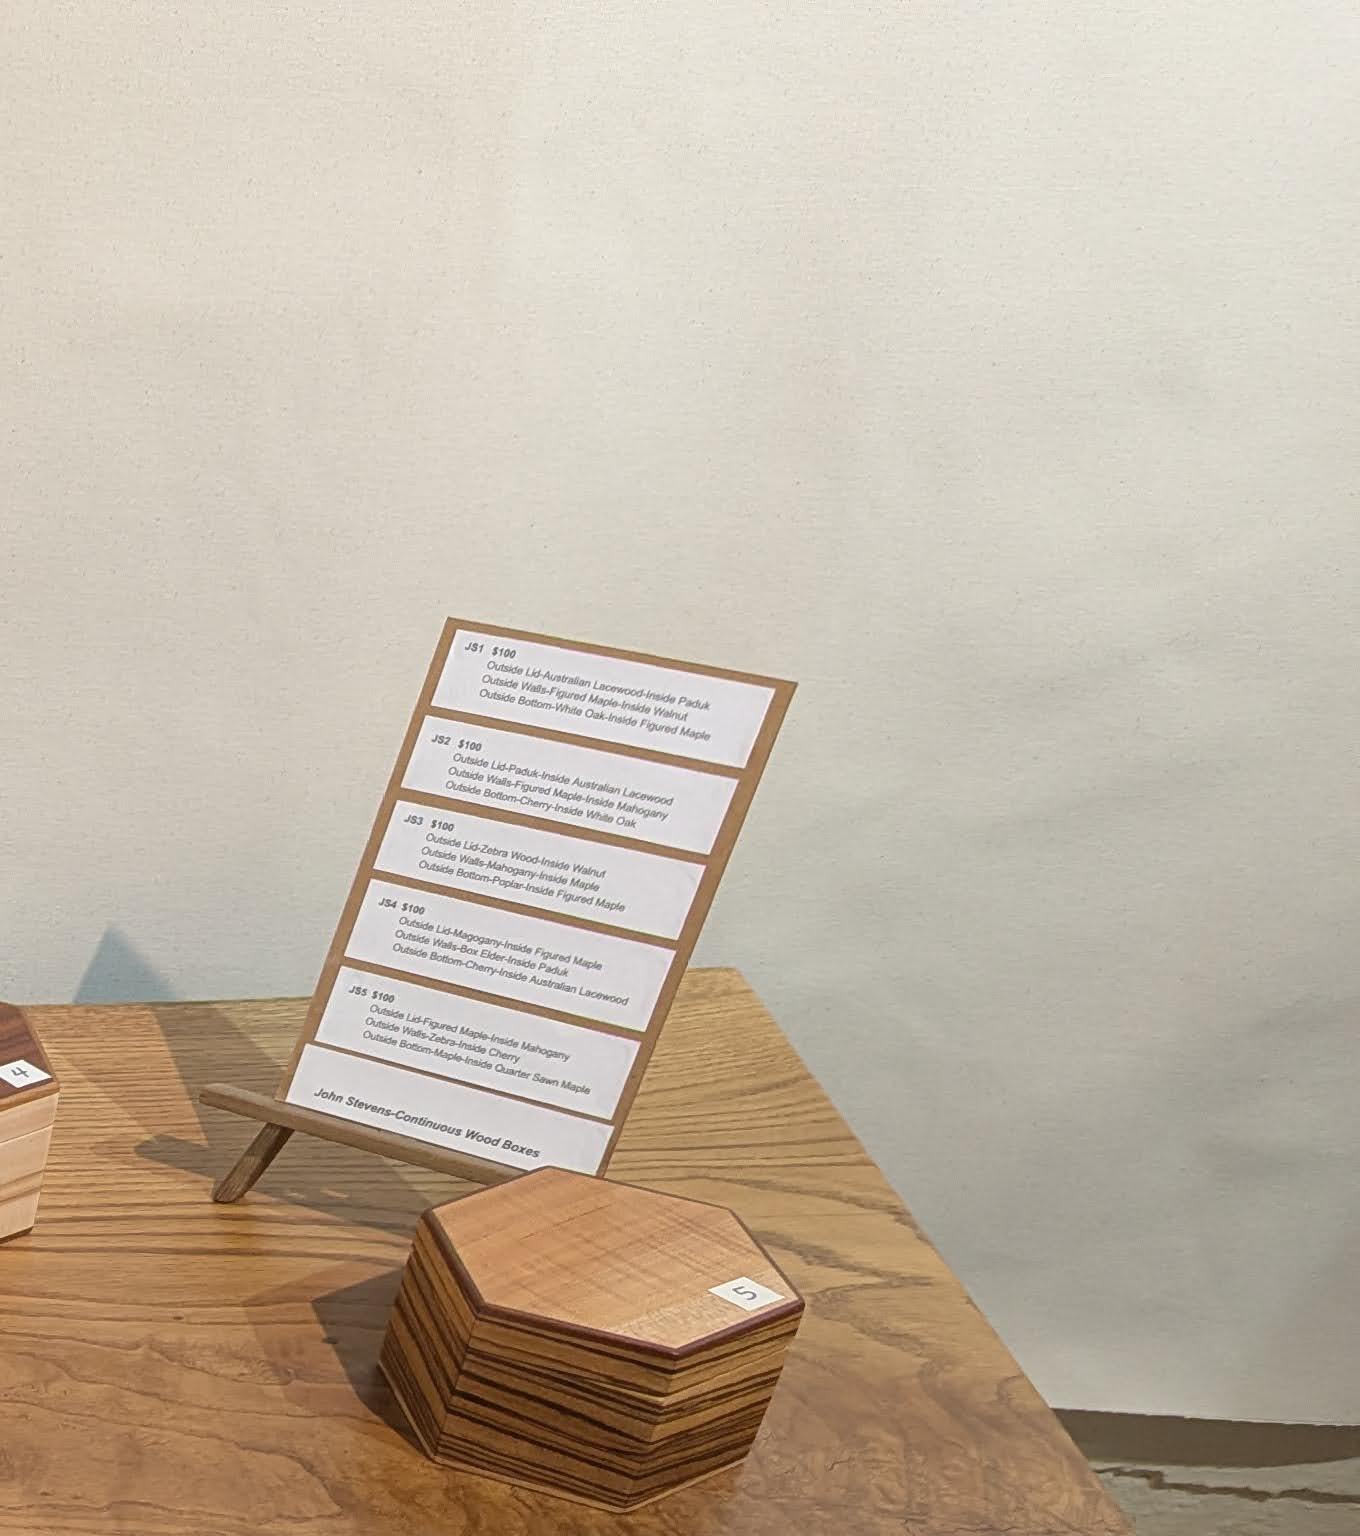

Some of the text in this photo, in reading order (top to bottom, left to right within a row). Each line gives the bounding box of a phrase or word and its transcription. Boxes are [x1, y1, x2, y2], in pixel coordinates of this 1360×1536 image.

[464, 641, 517, 660] JS1 $100
[481, 673, 520, 690] Outside
[653, 705, 689, 722] Walnut
[486, 660, 524, 676] Outside
[677, 696, 711, 711] Paduk
[479, 688, 517, 704] Outside
[639, 718, 680, 735] Figured
[678, 725, 712, 742] Maple
[431, 734, 483, 752] JS2 $100
[445, 779, 482, 796] Outside
[615, 815, 637, 829] Oak
[447, 766, 485, 782] Outside
[615, 800, 670, 822] Mahogany
[452, 752, 490, 769] Outside
[570, 776, 621, 796] Australian
[621, 787, 675, 807] Lacewood
[403, 814, 455, 833] JS3 $100
[420, 845, 458, 862] Outside
[568, 877, 601, 893] Maple
[425, 832, 462, 849] Outside
[571, 863, 607, 879] Walnut
[377, 897, 426, 916] JS4 $100
[418, 859, 455, 876] Outside
[555, 888, 595, 906] Figured
[594, 897, 626, 913] Maple
[394, 929, 431, 945] Outside
[537, 961, 569, 978] Paduk
[398, 916, 435, 932] Outside
[533, 946, 572, 964] Figured
[572, 955, 603, 971] Maple
[348, 985, 395, 1004] JS5 $100
[392, 942, 429, 959] Outside
[527, 974, 578, 994] Australian
[578, 986, 630, 1007] Lacewood
[364, 1016, 401, 1033] Outside
[488, 1047, 521, 1065] Cherry
[369, 1003, 405, 1020] Outside
[520, 1041, 571, 1063] Mahogany
[10, 1067, 30, 1079] 4
[362, 1029, 399, 1047] Outside
[494, 1063, 532, 1080] Quarter
[531, 1072, 560, 1087] Sawn
[560, 1079, 592, 1095] Maple
[313, 1088, 344, 1104] John
[464, 1128, 502, 1147] Wood
[500, 1139, 541, 1158] Boxes
[731, 1285, 758, 1301] 5
